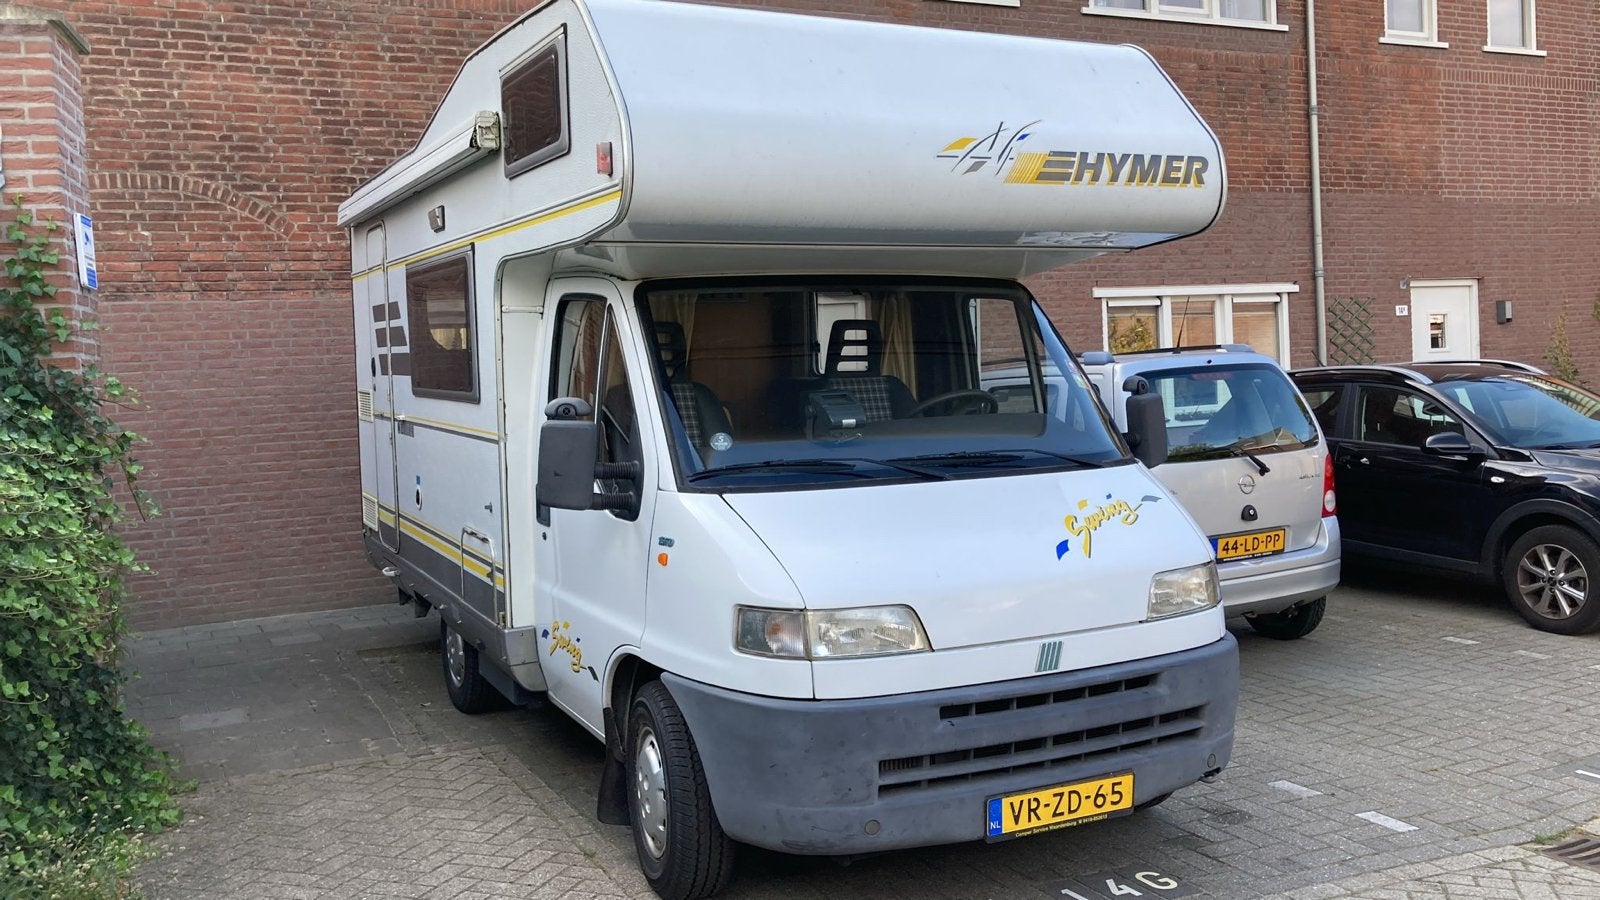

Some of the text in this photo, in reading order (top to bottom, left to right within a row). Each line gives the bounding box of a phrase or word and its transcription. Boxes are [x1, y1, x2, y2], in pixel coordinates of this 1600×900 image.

[1071, 151, 1209, 188] HYMER
[1064, 493, 1139, 559] Swing
[1221, 533, 1281, 555] 44-LD-PP
[1009, 781, 1123, 826] VR-ZD-65
[990, 821, 1001, 829] NL
